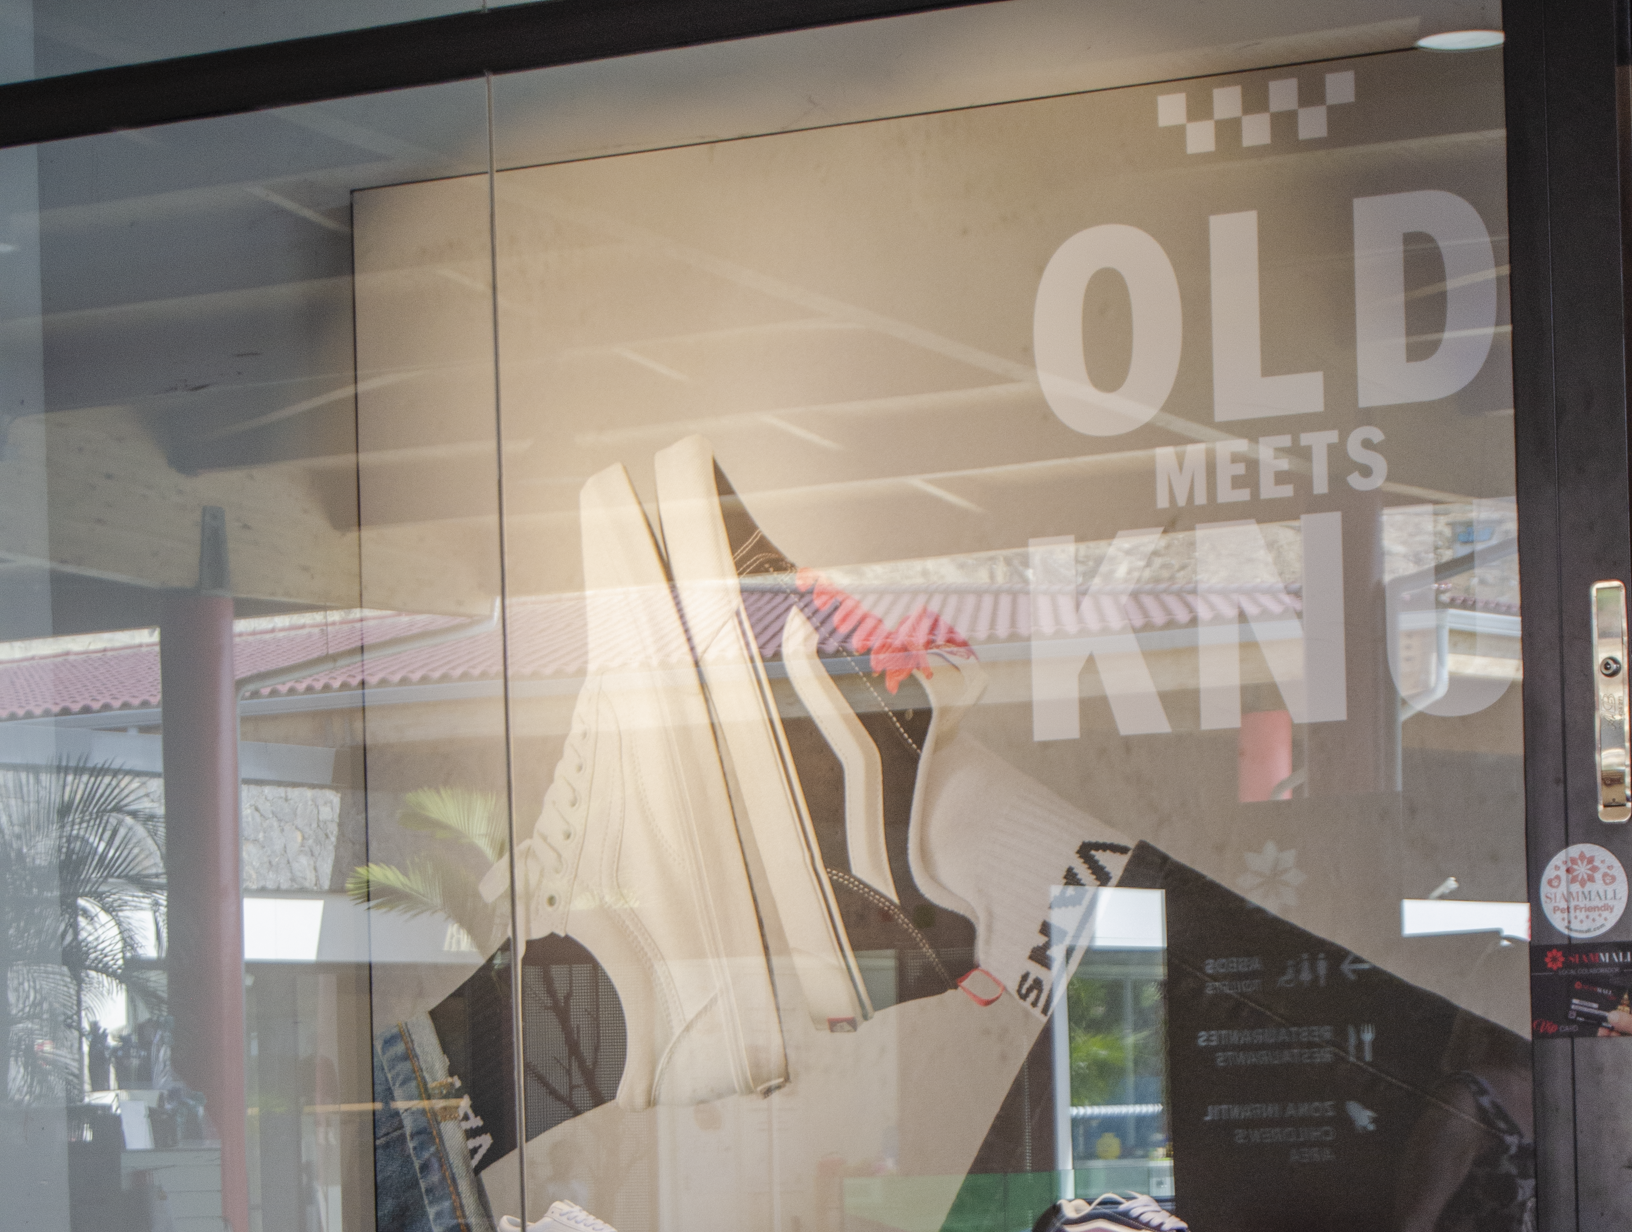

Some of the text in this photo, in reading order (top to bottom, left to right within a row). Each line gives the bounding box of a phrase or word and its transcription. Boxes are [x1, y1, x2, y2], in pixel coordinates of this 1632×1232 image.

[1033, 190, 1498, 437] OLD
[1154, 425, 1388, 509] MEETS
[1028, 496, 1518, 742] KNU
[1544, 889, 1622, 905] SIAMMALL
[1552, 902, 1615, 915] Pet Friendly
